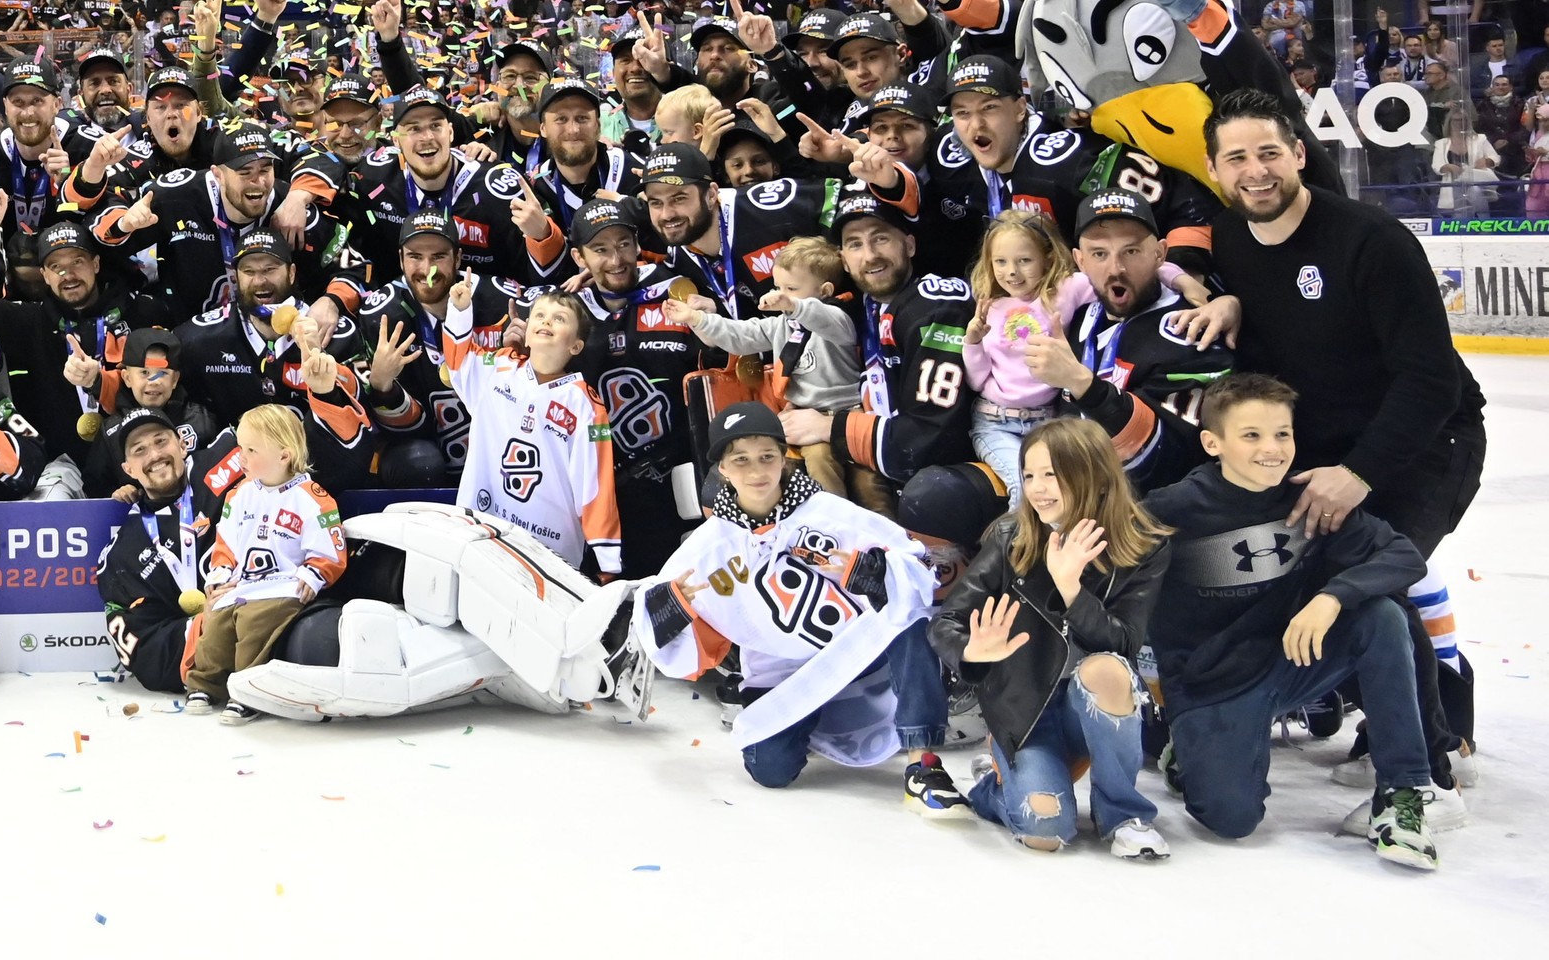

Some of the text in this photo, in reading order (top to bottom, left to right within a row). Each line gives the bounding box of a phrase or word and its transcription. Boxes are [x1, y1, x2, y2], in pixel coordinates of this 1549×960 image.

[1306, 82, 1430, 148] AQ
[1041, 133, 1072, 158] USS
[492, 168, 521, 193] USS
[1118, 150, 1159, 202] 84
[1402, 223, 1427, 231] OS
[924, 276, 966, 295] USS
[1475, 266, 1549, 317] MINE
[639, 341, 687, 352] MORIS
[933, 328, 965, 343] ŠKO
[206, 364, 252, 374] PANDA-KOŠICE
[916, 358, 963, 408] 18
[510, 512, 530, 530] Steel
[531, 522, 561, 541] Košice
[1197, 587, 1258, 598] UNDER
[44, 632, 111, 648] ŠKODA
